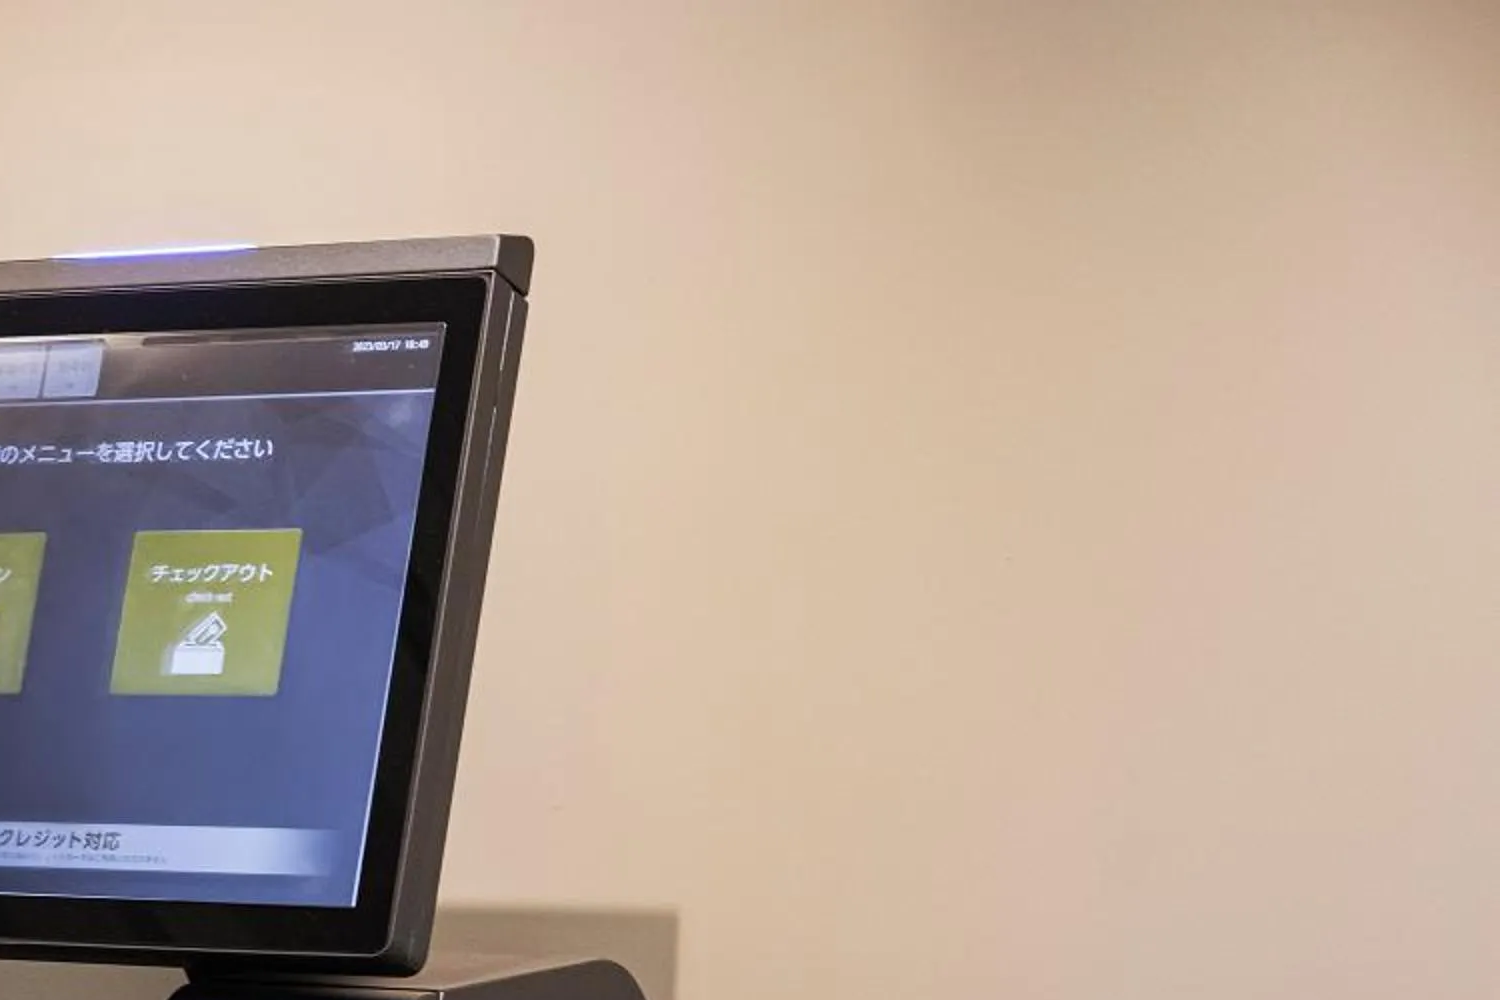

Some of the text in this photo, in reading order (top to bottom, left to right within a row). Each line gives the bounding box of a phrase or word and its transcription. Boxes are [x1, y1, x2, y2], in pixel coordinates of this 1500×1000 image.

[150, 563, 273, 582] チェックアウト
